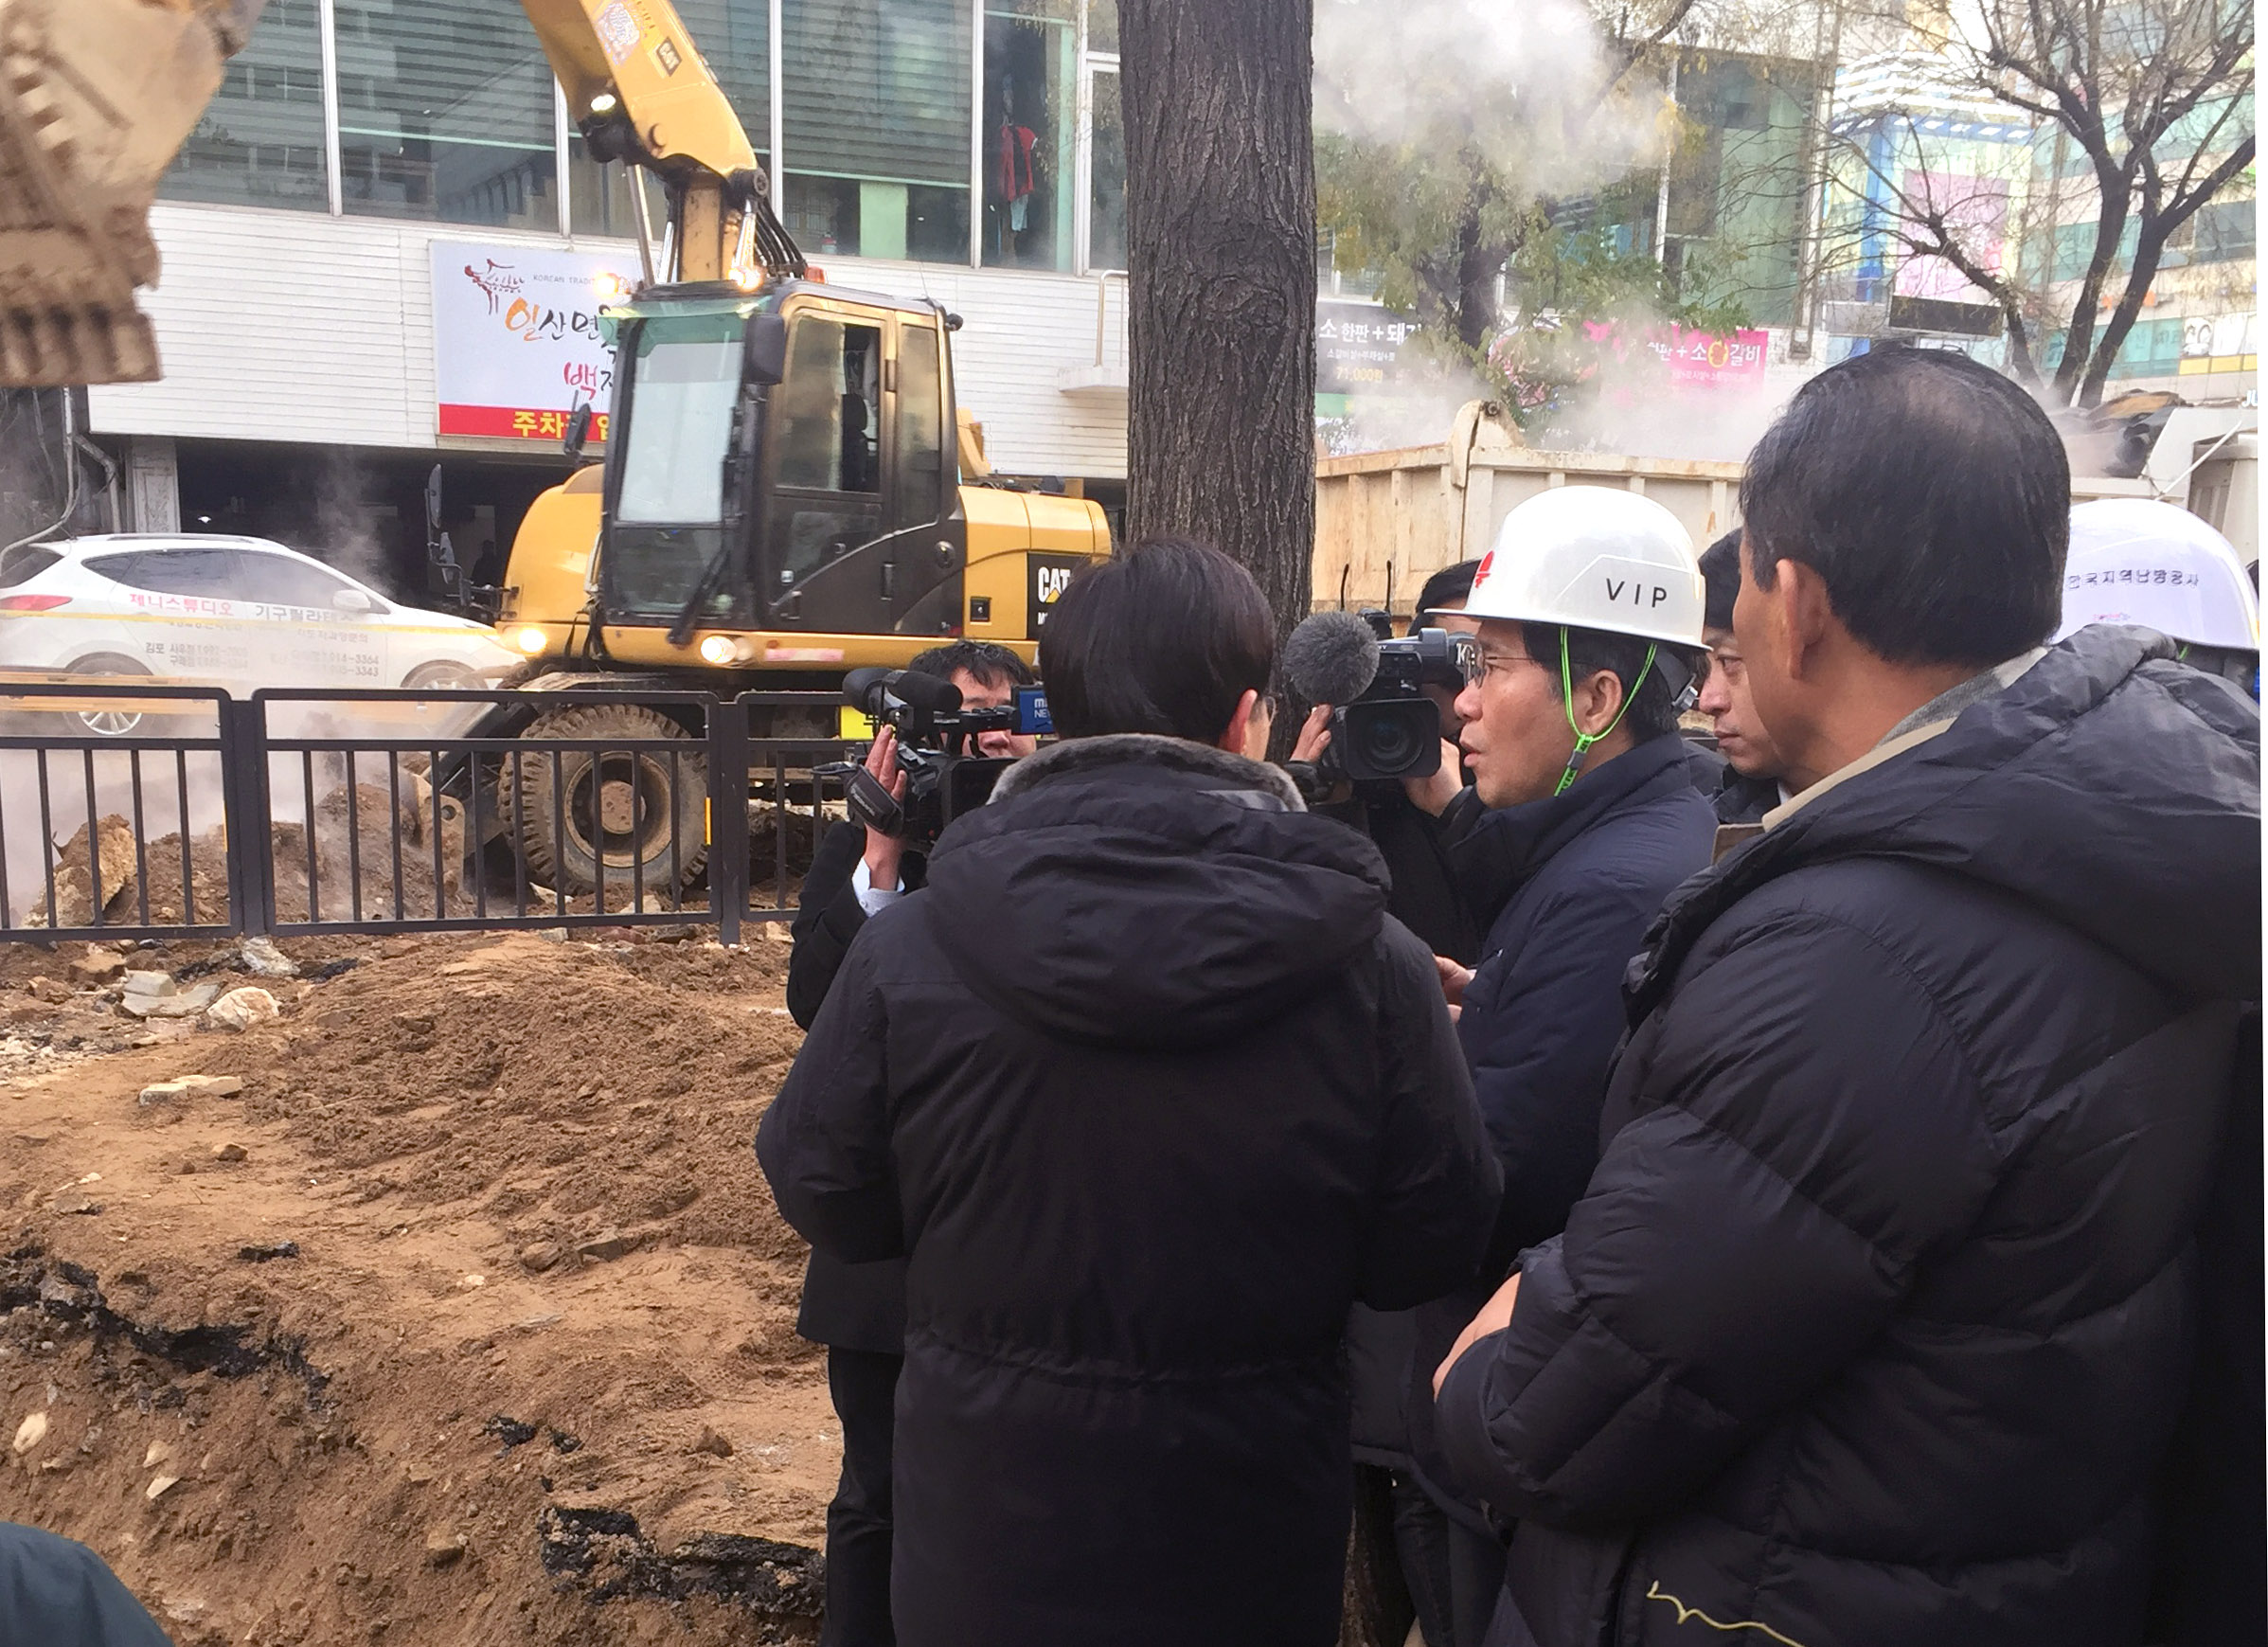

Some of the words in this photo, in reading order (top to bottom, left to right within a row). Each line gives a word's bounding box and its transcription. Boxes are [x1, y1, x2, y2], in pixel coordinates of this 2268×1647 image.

[505, 296, 612, 342] 일산면
[1319, 318, 1338, 339] 소
[1341, 322, 1369, 343] 한판
[512, 411, 572, 439] 주차
[1038, 566, 1071, 604] CAT
[1605, 577, 1668, 608] VIP
[145, 642, 166, 655] 김포
